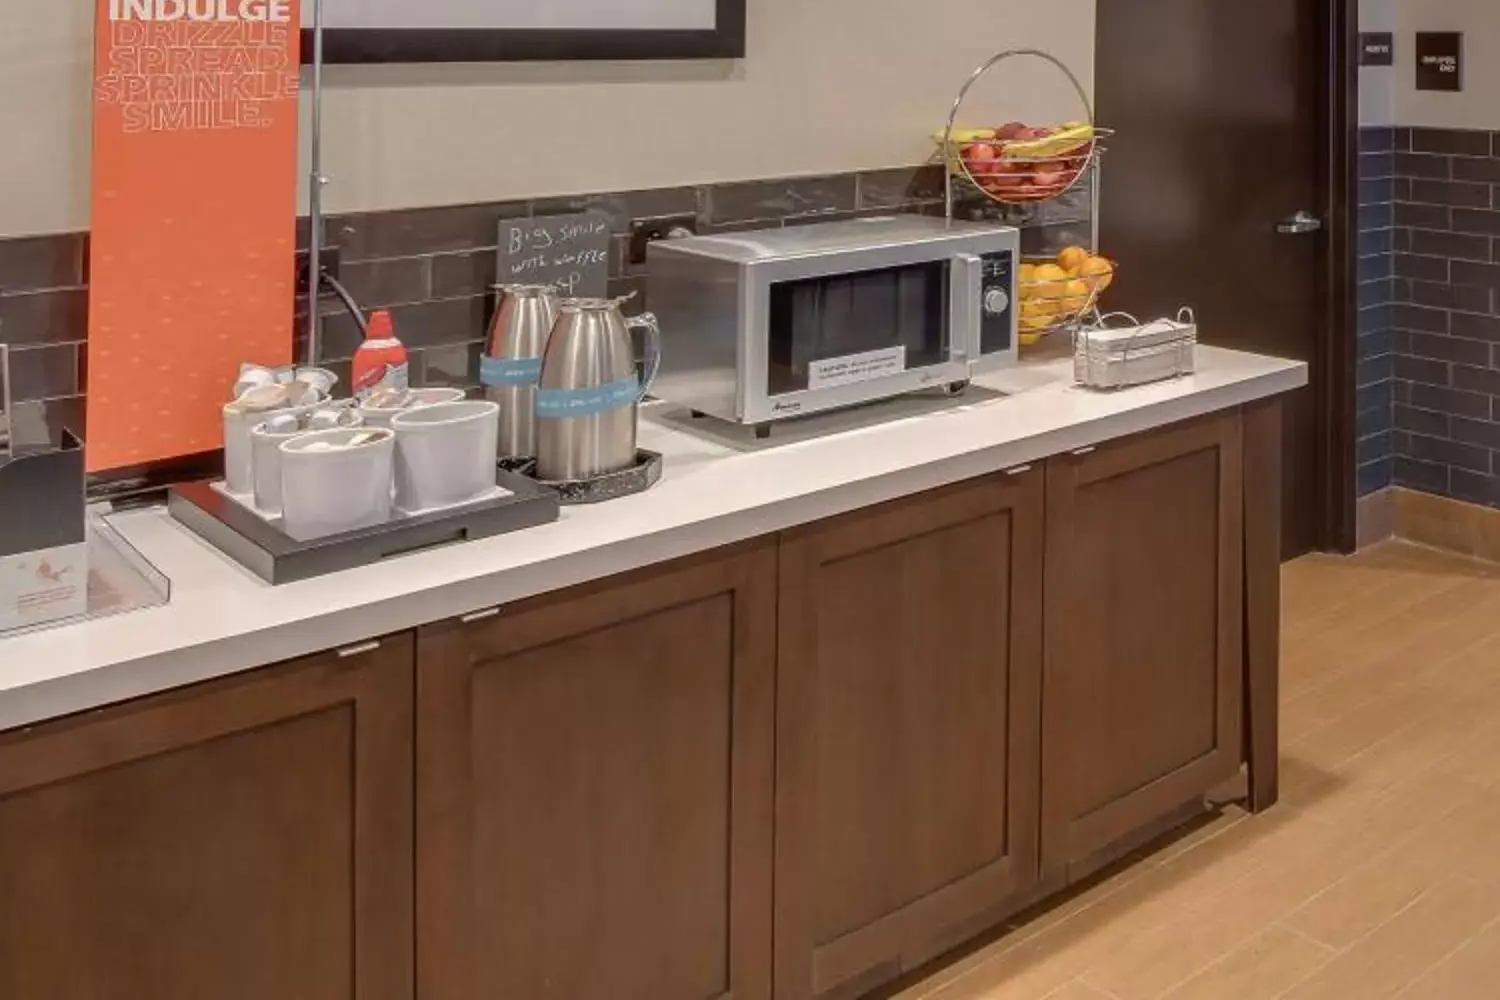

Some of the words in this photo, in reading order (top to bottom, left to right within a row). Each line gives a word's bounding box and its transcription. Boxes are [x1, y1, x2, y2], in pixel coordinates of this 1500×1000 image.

[111, 21, 288, 48] DRIZZLE
[108, 47, 289, 74] SPREAD
[96, 72, 299, 102] SPRINKLE
[122, 100, 273, 132] SMILE.
